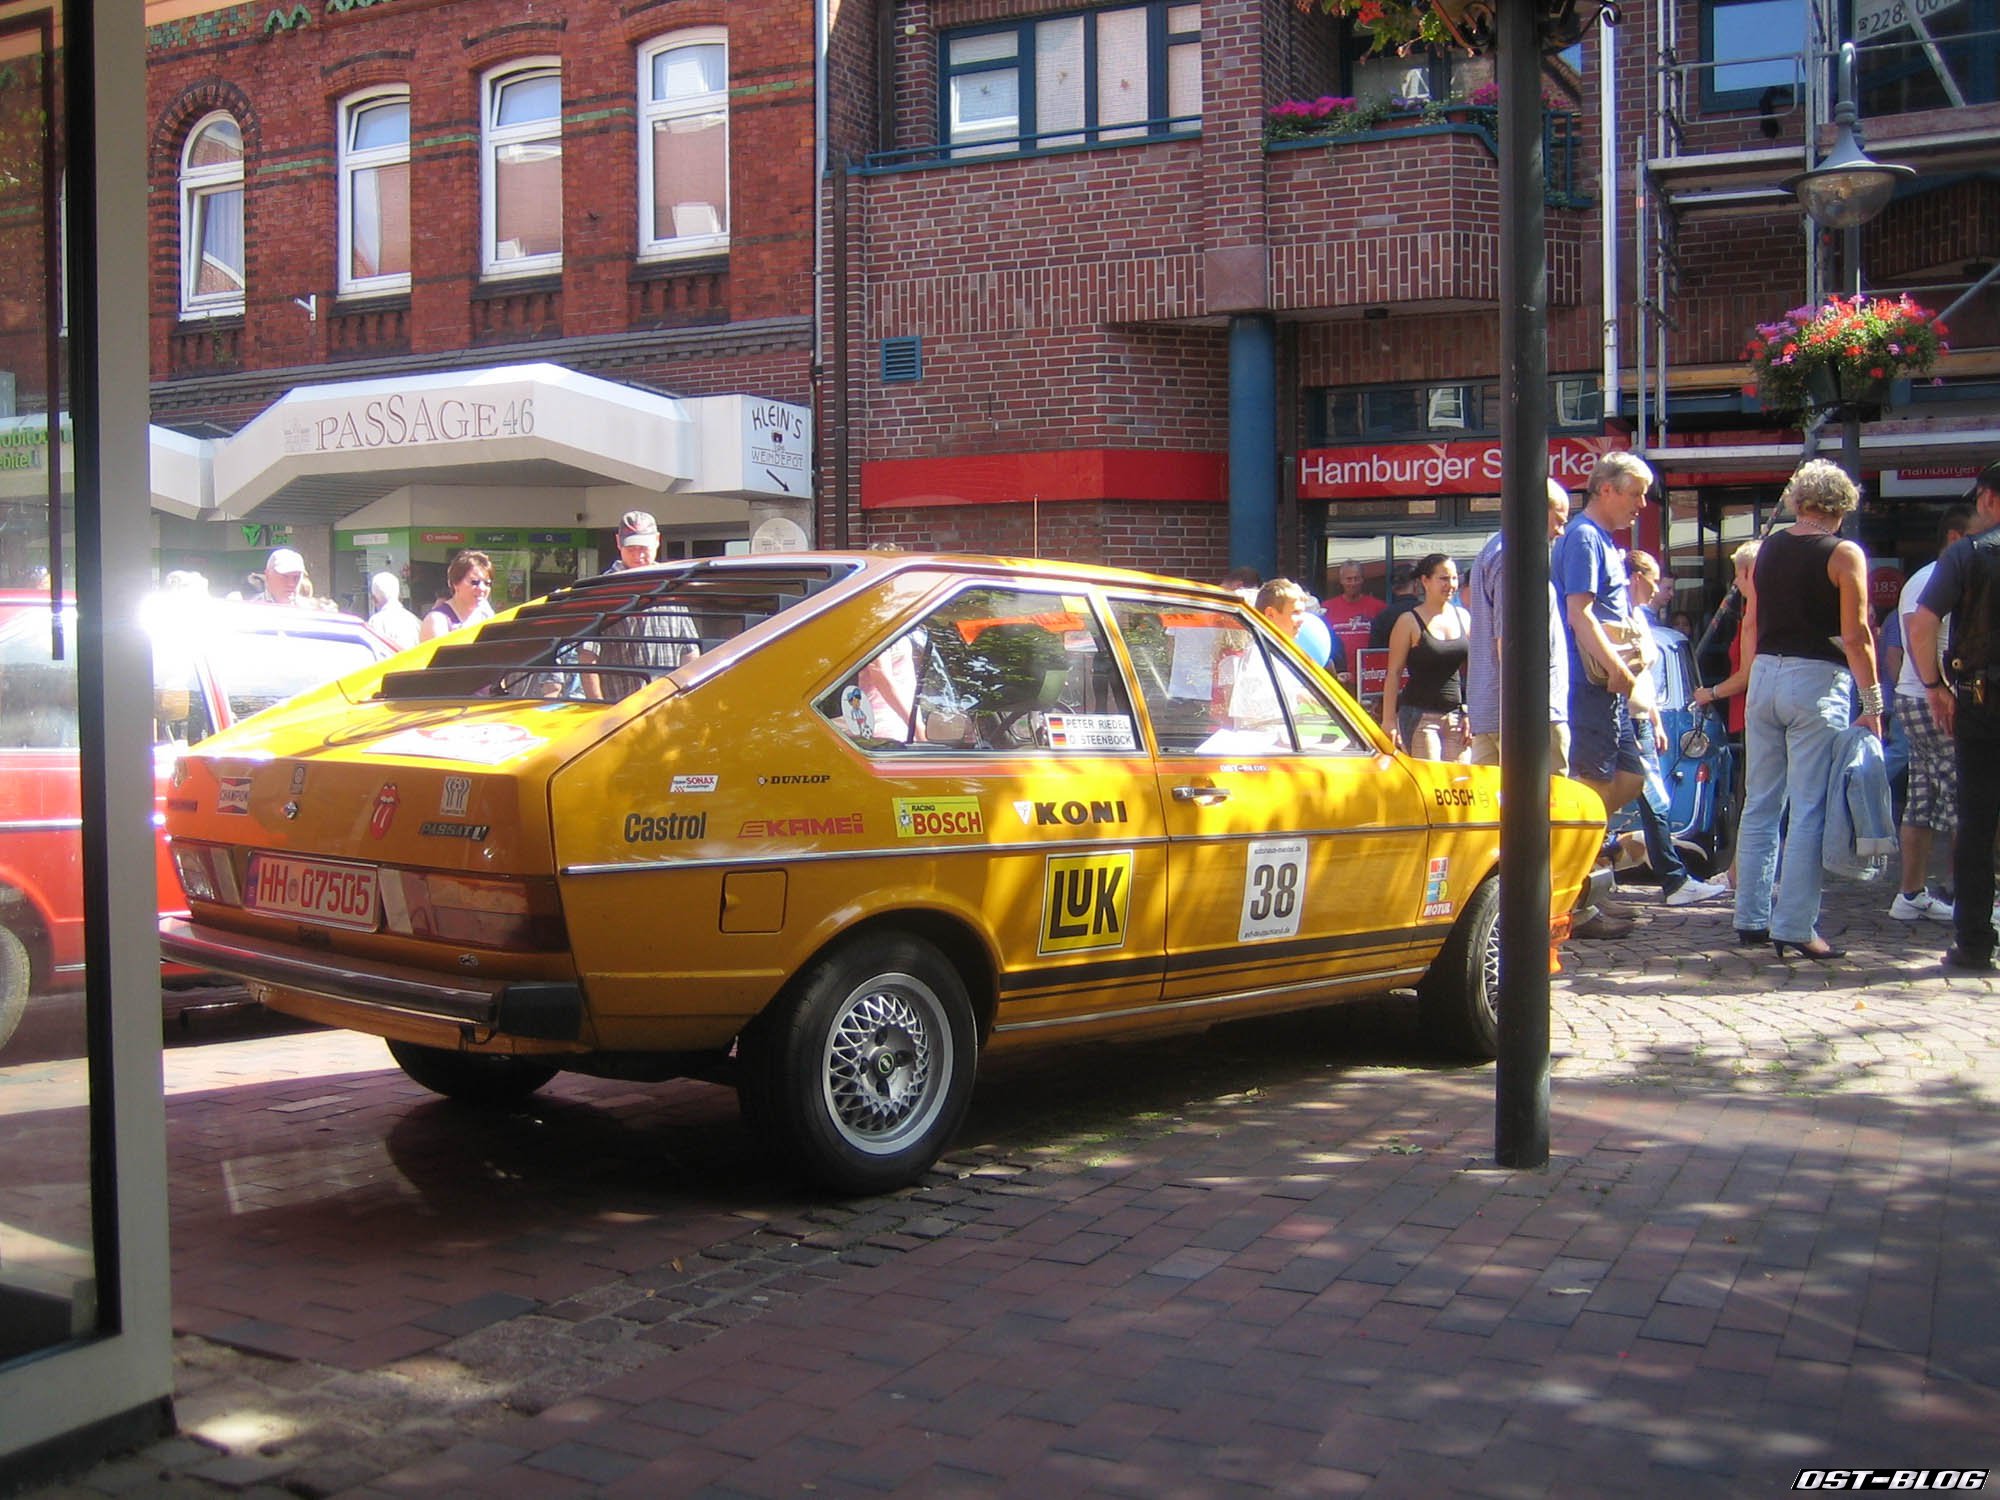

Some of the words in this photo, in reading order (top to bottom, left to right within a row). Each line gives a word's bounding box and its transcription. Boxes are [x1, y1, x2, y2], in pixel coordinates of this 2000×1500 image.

[316, 394, 499, 450] PASSAGE
[502, 398, 535, 435] 46
[752, 405, 803, 439] KLEIN'S
[752, 450, 803, 467] WEINDEPOT
[1301, 454, 1476, 486] Hamburger
[1873, 581, 1897, 592] 185
[1066, 718, 1094, 729] PETER
[1098, 719, 1129, 730] RIEDEL
[1081, 735, 1132, 745] STEENBOCK
[687, 777, 714, 785] SONAX
[771, 775, 831, 785] DUNLOP
[1434, 788, 1476, 806] BOSCH
[912, 804, 936, 812] RACING
[1035, 800, 1128, 825] KONI
[421, 823, 473, 837] PASSAT
[624, 812, 706, 843] Castrol
[912, 811, 982, 835] BOSCH
[260, 863, 289, 905] HH
[301, 868, 371, 916] 07505
[1250, 863, 1298, 921] 38
[1423, 902, 1452, 916] MOTUL
